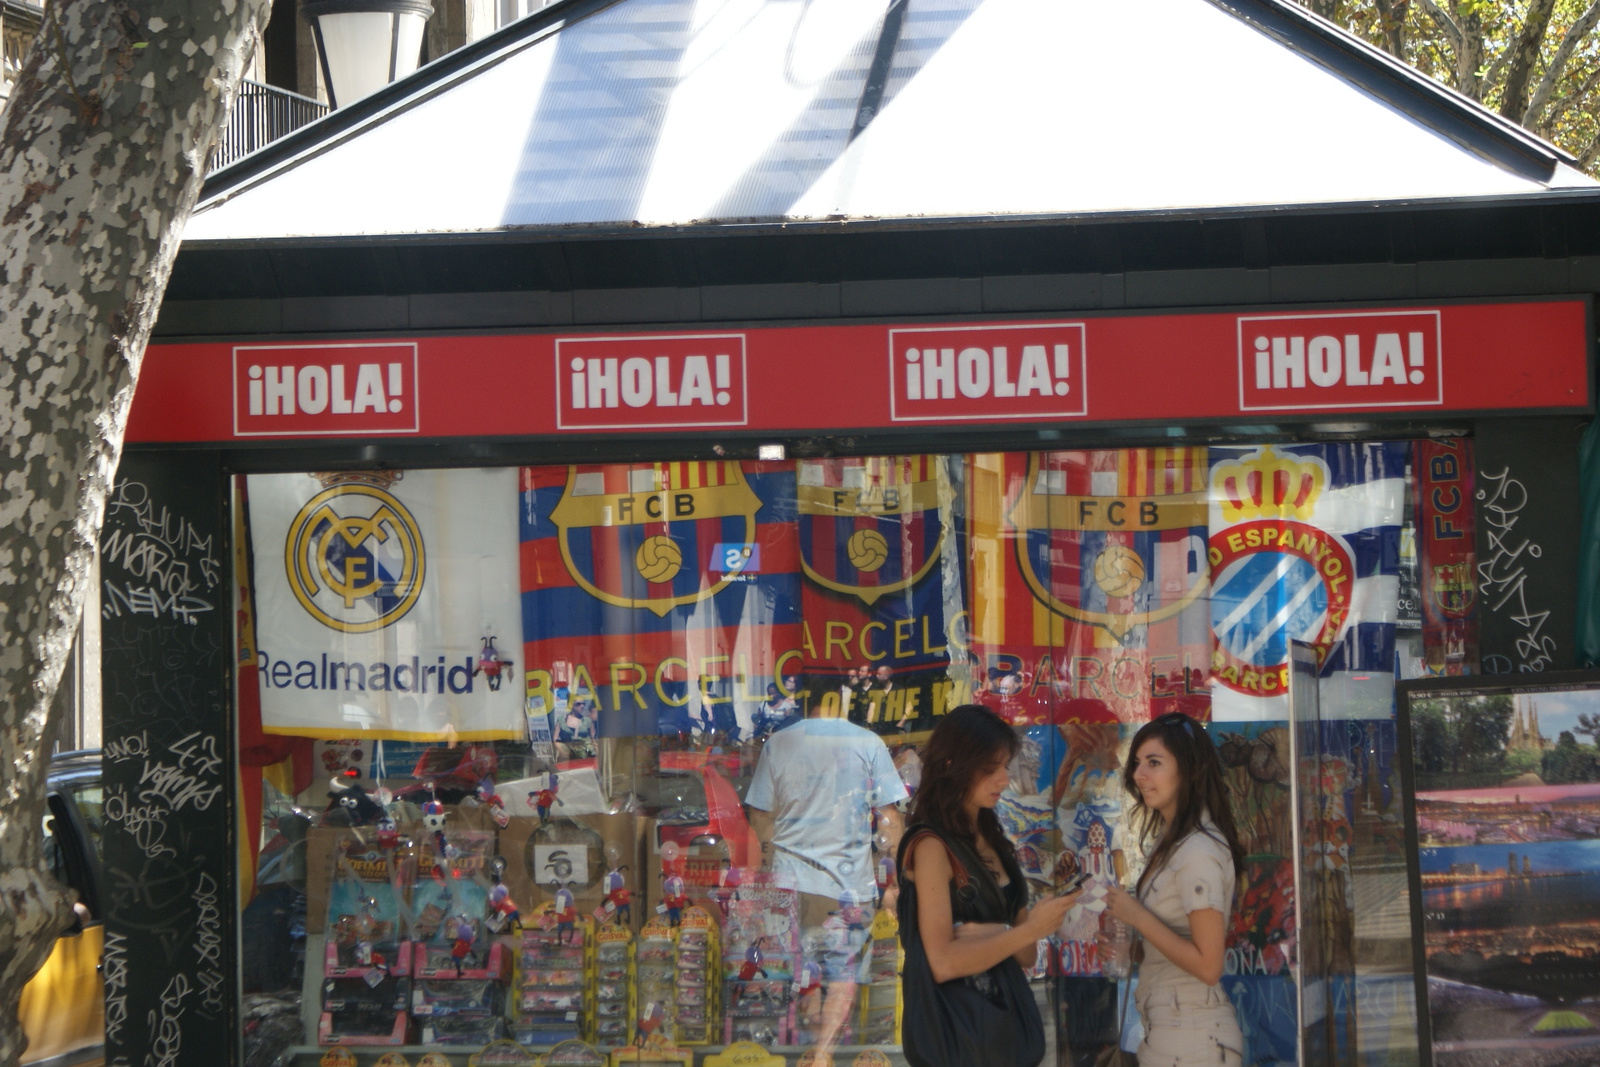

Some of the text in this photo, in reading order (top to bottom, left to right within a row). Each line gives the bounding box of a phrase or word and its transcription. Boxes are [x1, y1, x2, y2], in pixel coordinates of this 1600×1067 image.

[570, 354, 732, 409] ¡HOLA!
[905, 344, 1071, 400] ¡HOLA!
[1254, 331, 1426, 389] ¡HOLA!
[248, 363, 404, 416] ¡HOLA!
[617, 493, 695, 521] FCB
[833, 488, 900, 512] FCB
[1079, 500, 1160, 527] FCB
[1226, 527, 1348, 594] ESPANYOL
[867, 686, 921, 723] THE
